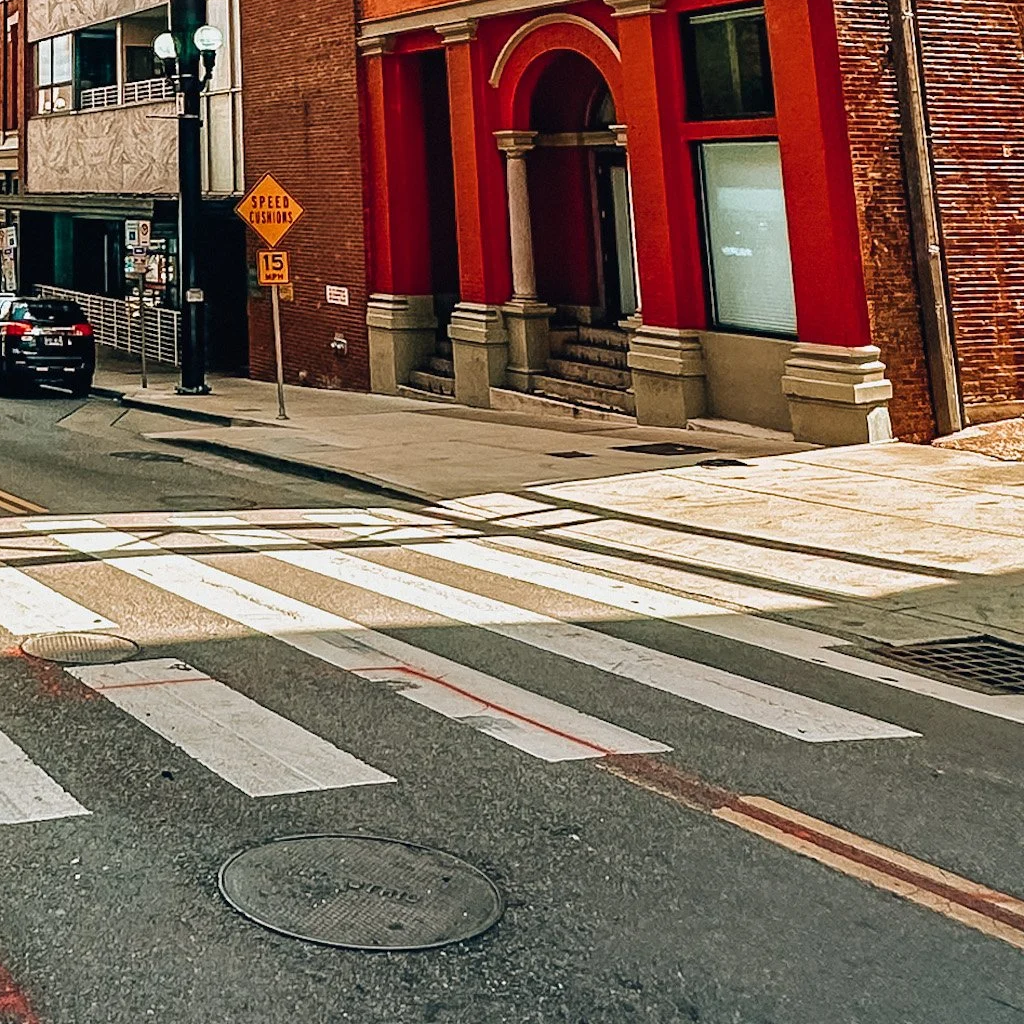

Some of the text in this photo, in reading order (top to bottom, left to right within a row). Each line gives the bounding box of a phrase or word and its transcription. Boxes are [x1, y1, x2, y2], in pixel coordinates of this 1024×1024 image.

[251, 195, 289, 209] SPEED
[249, 211, 293, 225] CUSHIONS
[263, 254, 284, 271] 15
[265, 273, 284, 281] MPH
